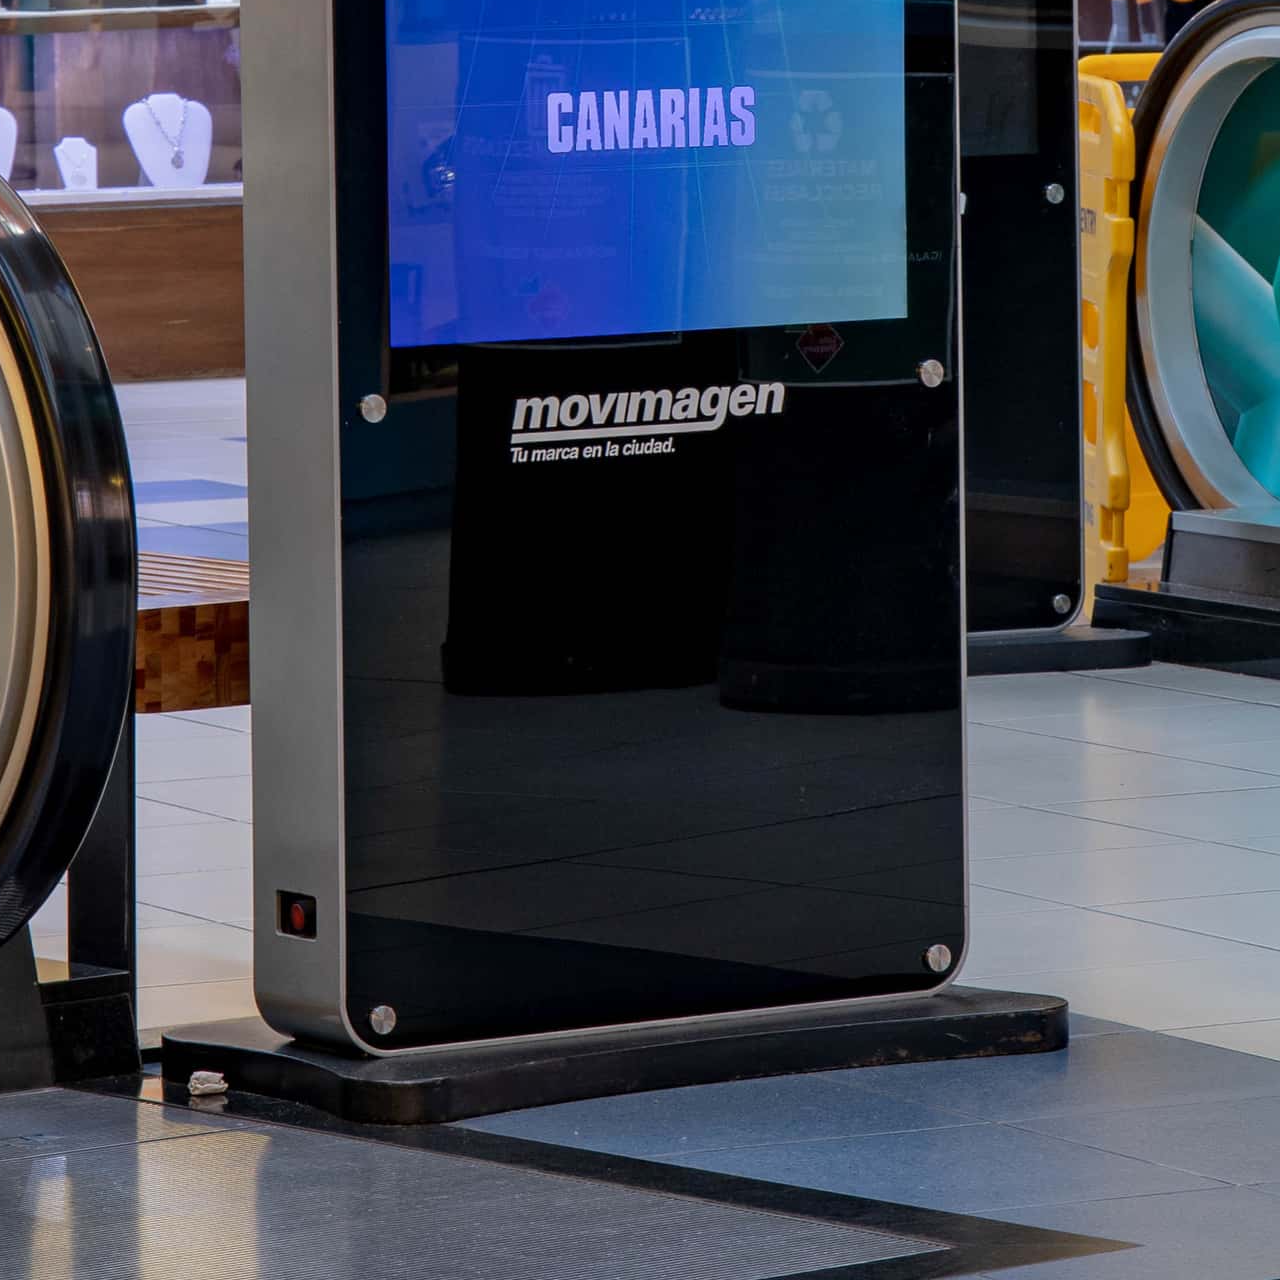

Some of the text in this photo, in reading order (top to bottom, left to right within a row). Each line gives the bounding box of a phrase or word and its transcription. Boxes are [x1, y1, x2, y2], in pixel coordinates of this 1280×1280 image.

[547, 86, 756, 153] CANARIAS
[511, 382, 785, 432] movimagen
[511, 437, 675, 463] Tu marca en la ciudad.
